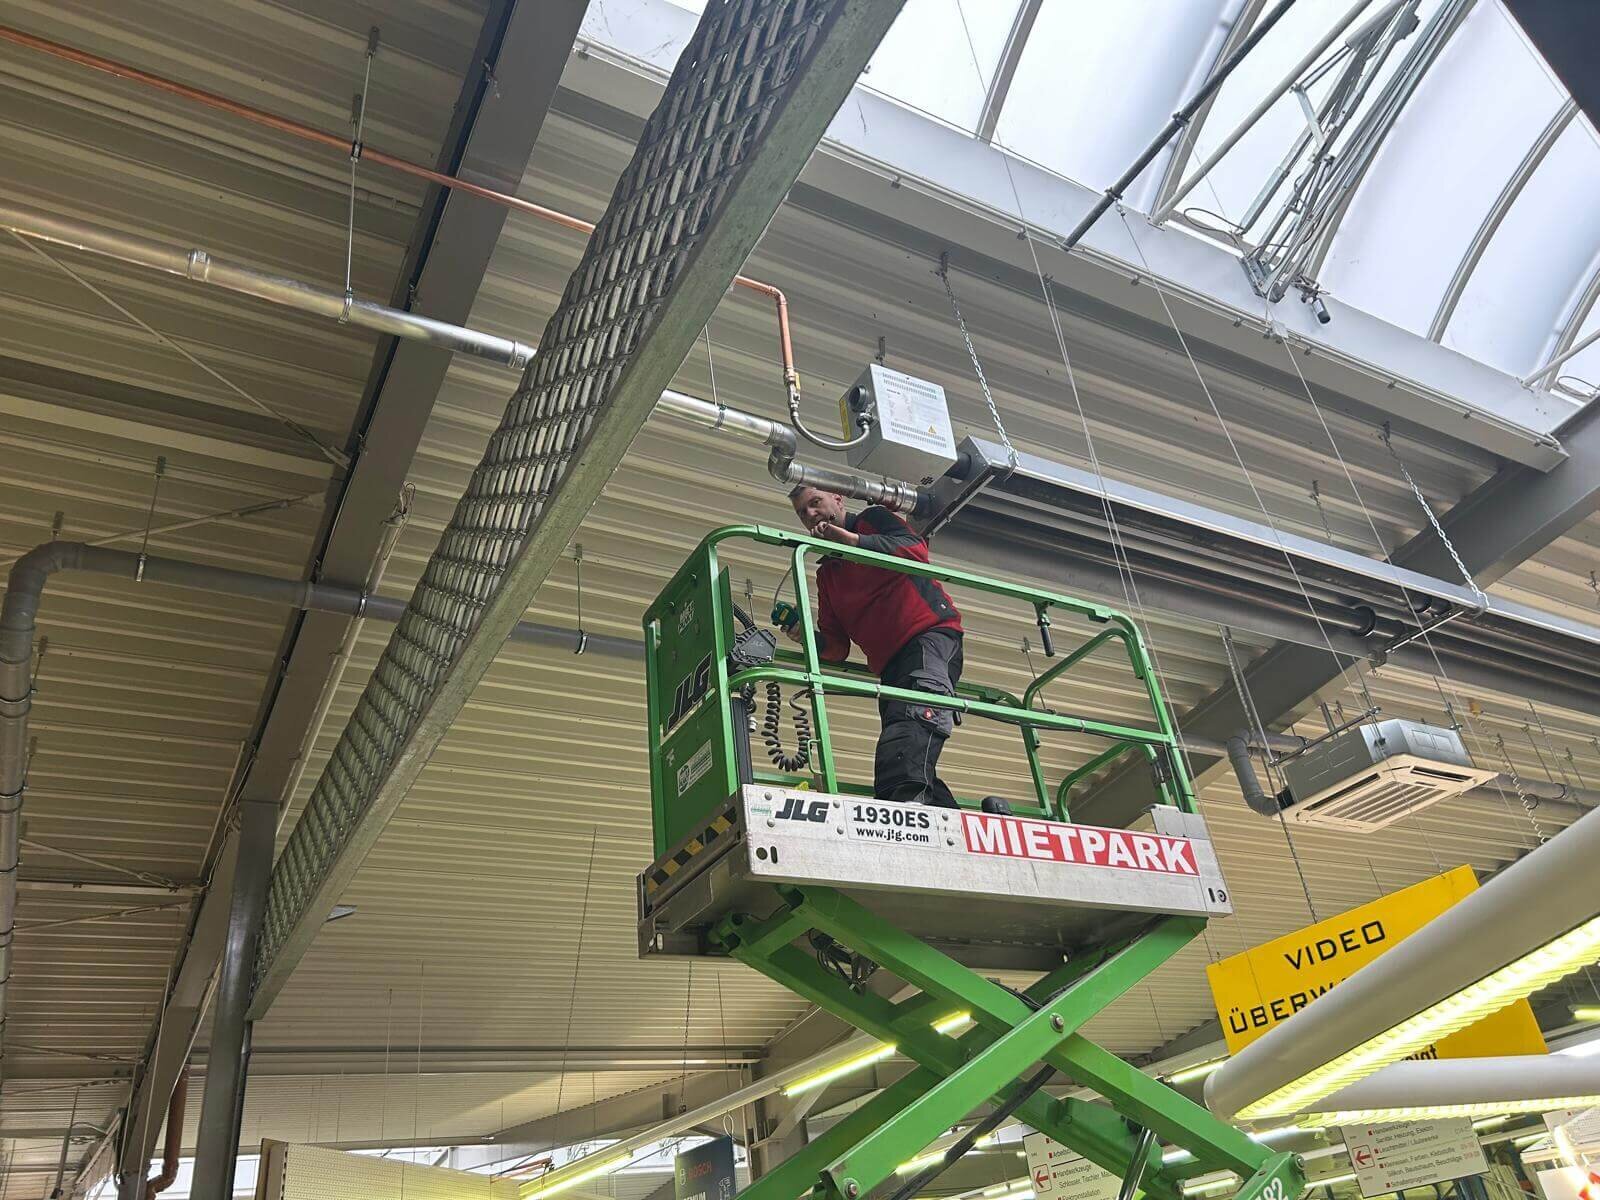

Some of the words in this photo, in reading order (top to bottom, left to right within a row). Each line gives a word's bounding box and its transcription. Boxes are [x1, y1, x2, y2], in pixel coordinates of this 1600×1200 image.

[663, 651, 713, 736] JLG
[774, 798, 830, 823] JLG
[853, 804, 930, 829] 1930ES
[856, 826, 930, 843] www.jlg.com
[967, 817, 1195, 873] MIETPARK
[1284, 920, 1386, 970] VIDEO
[1229, 977, 1346, 1034] ÜBERW
